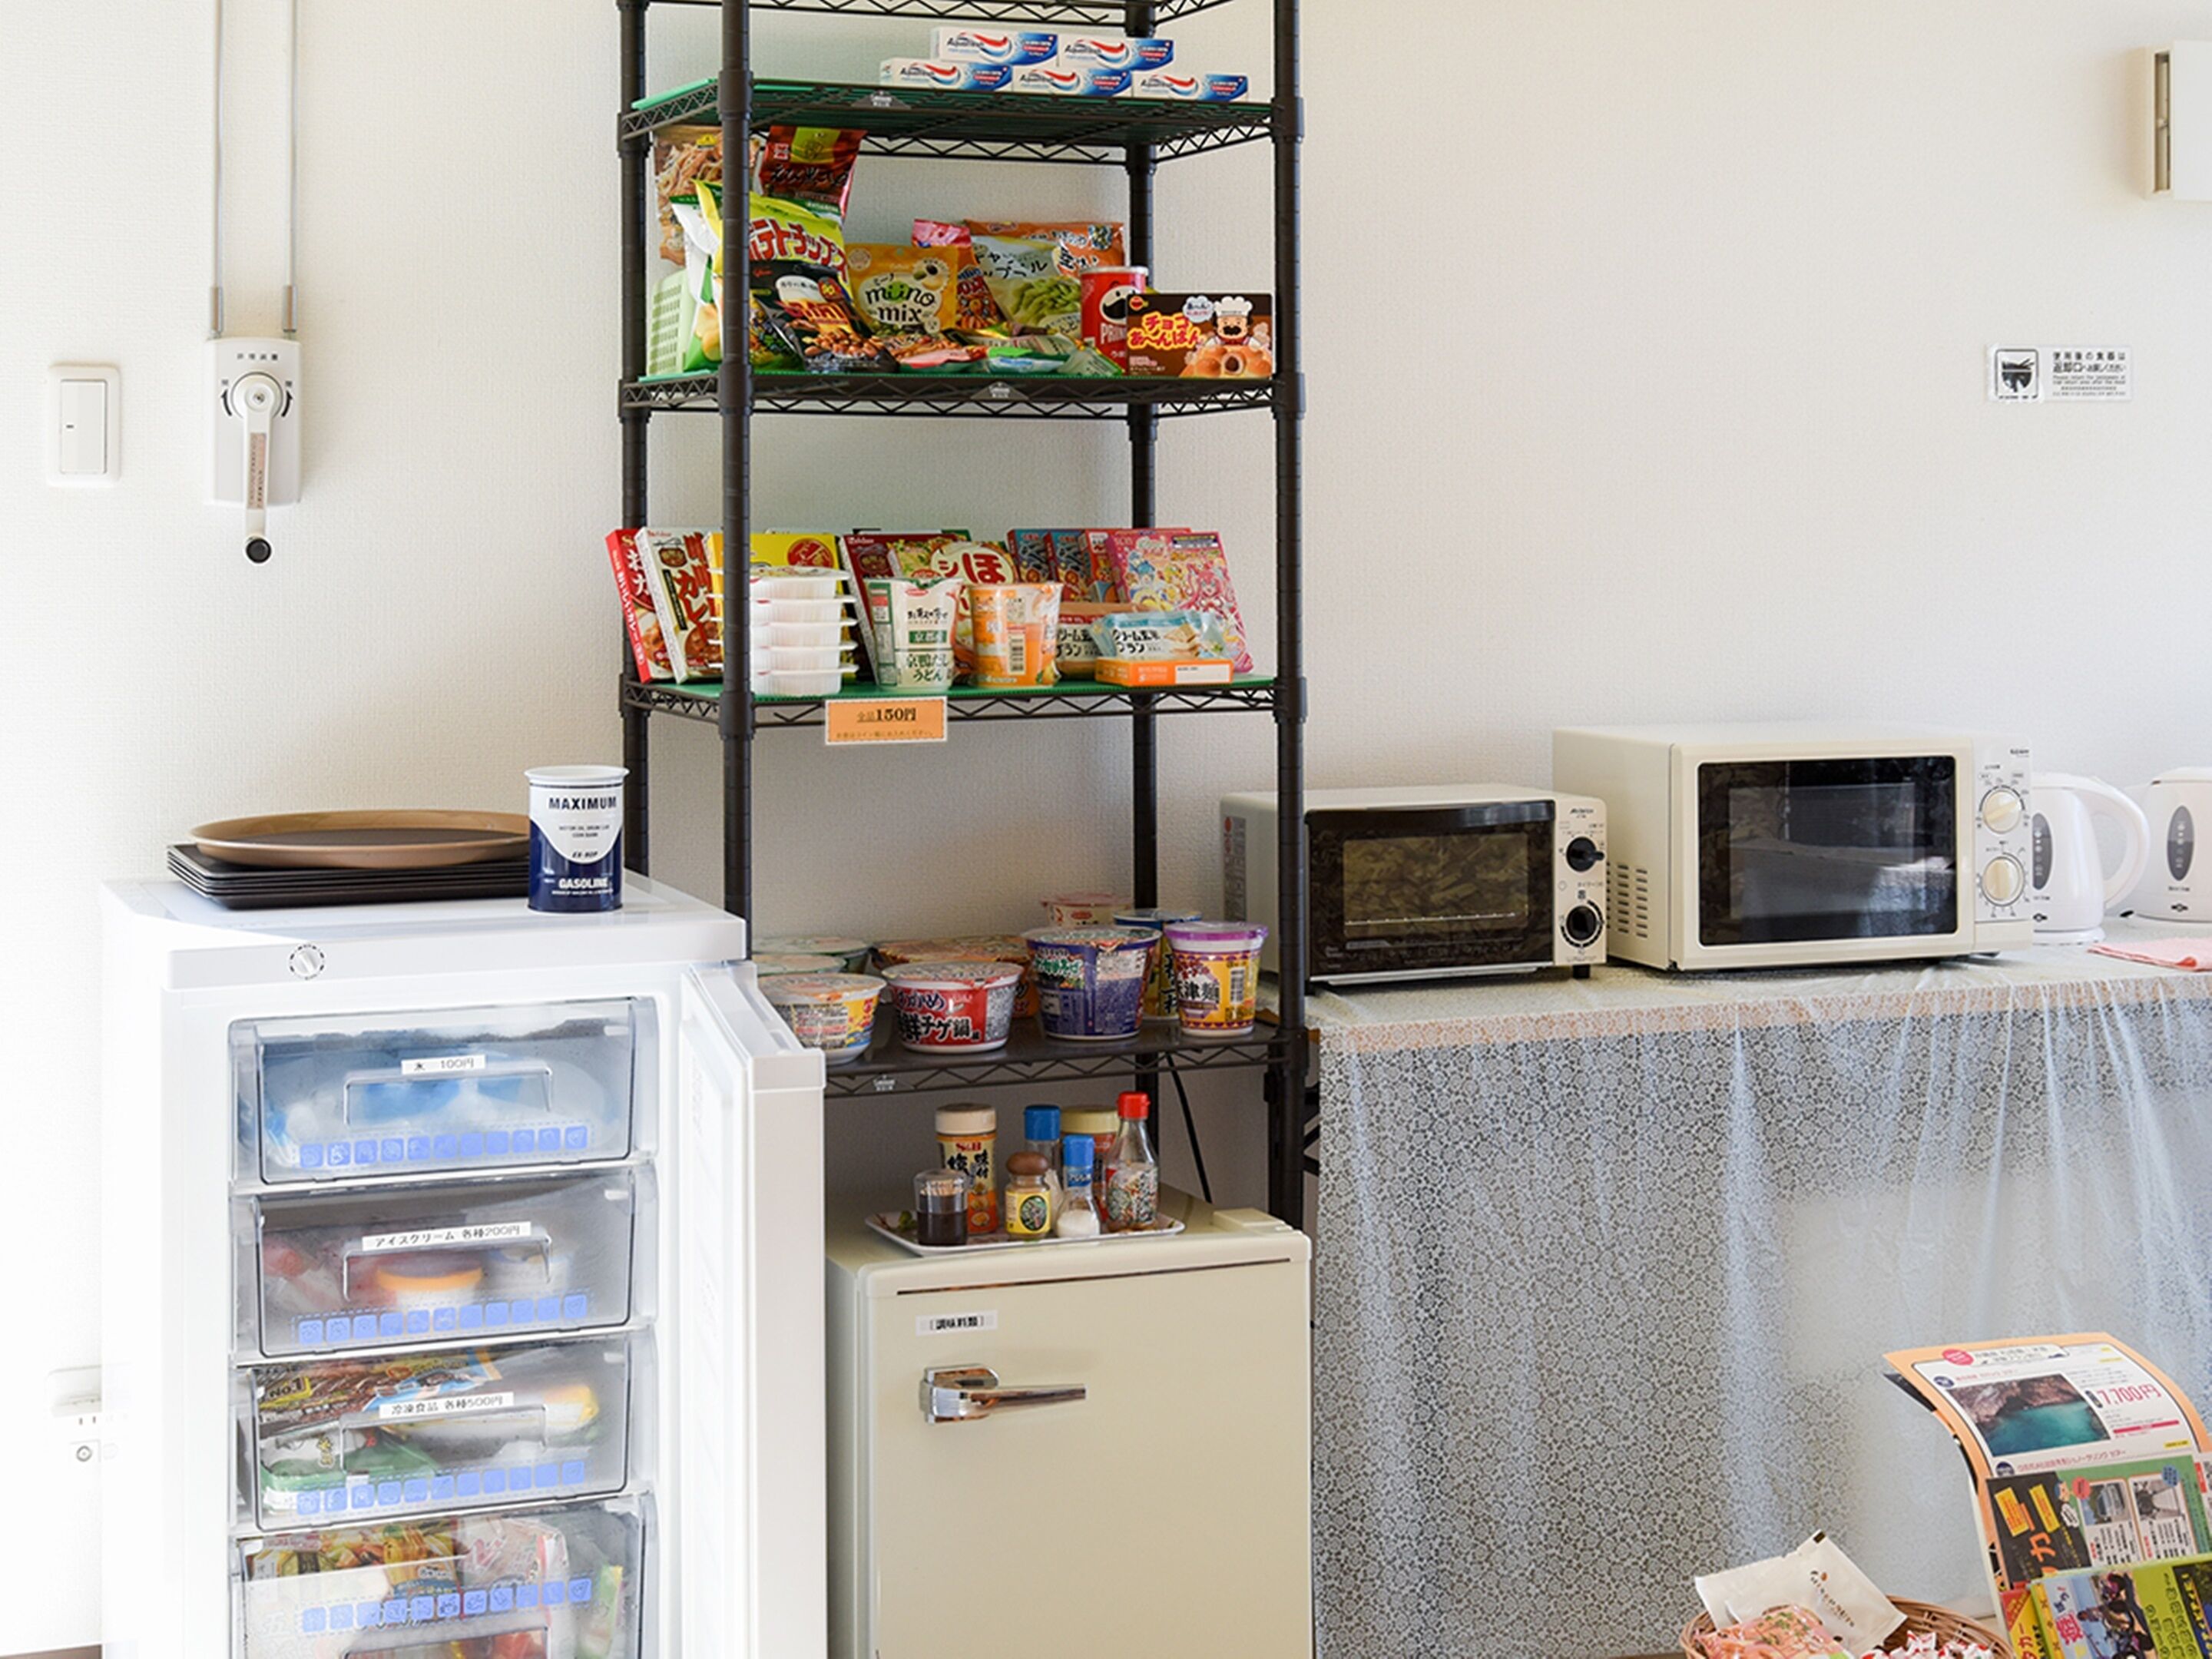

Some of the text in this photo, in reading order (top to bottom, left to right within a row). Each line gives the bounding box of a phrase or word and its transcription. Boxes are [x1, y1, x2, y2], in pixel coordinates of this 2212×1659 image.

[878, 304, 922, 322] mix
[548, 796, 618, 810] MAXIMUM
[558, 878, 608, 889] GASOLINE
[374, 1230, 455, 1248] アイスクリーム
